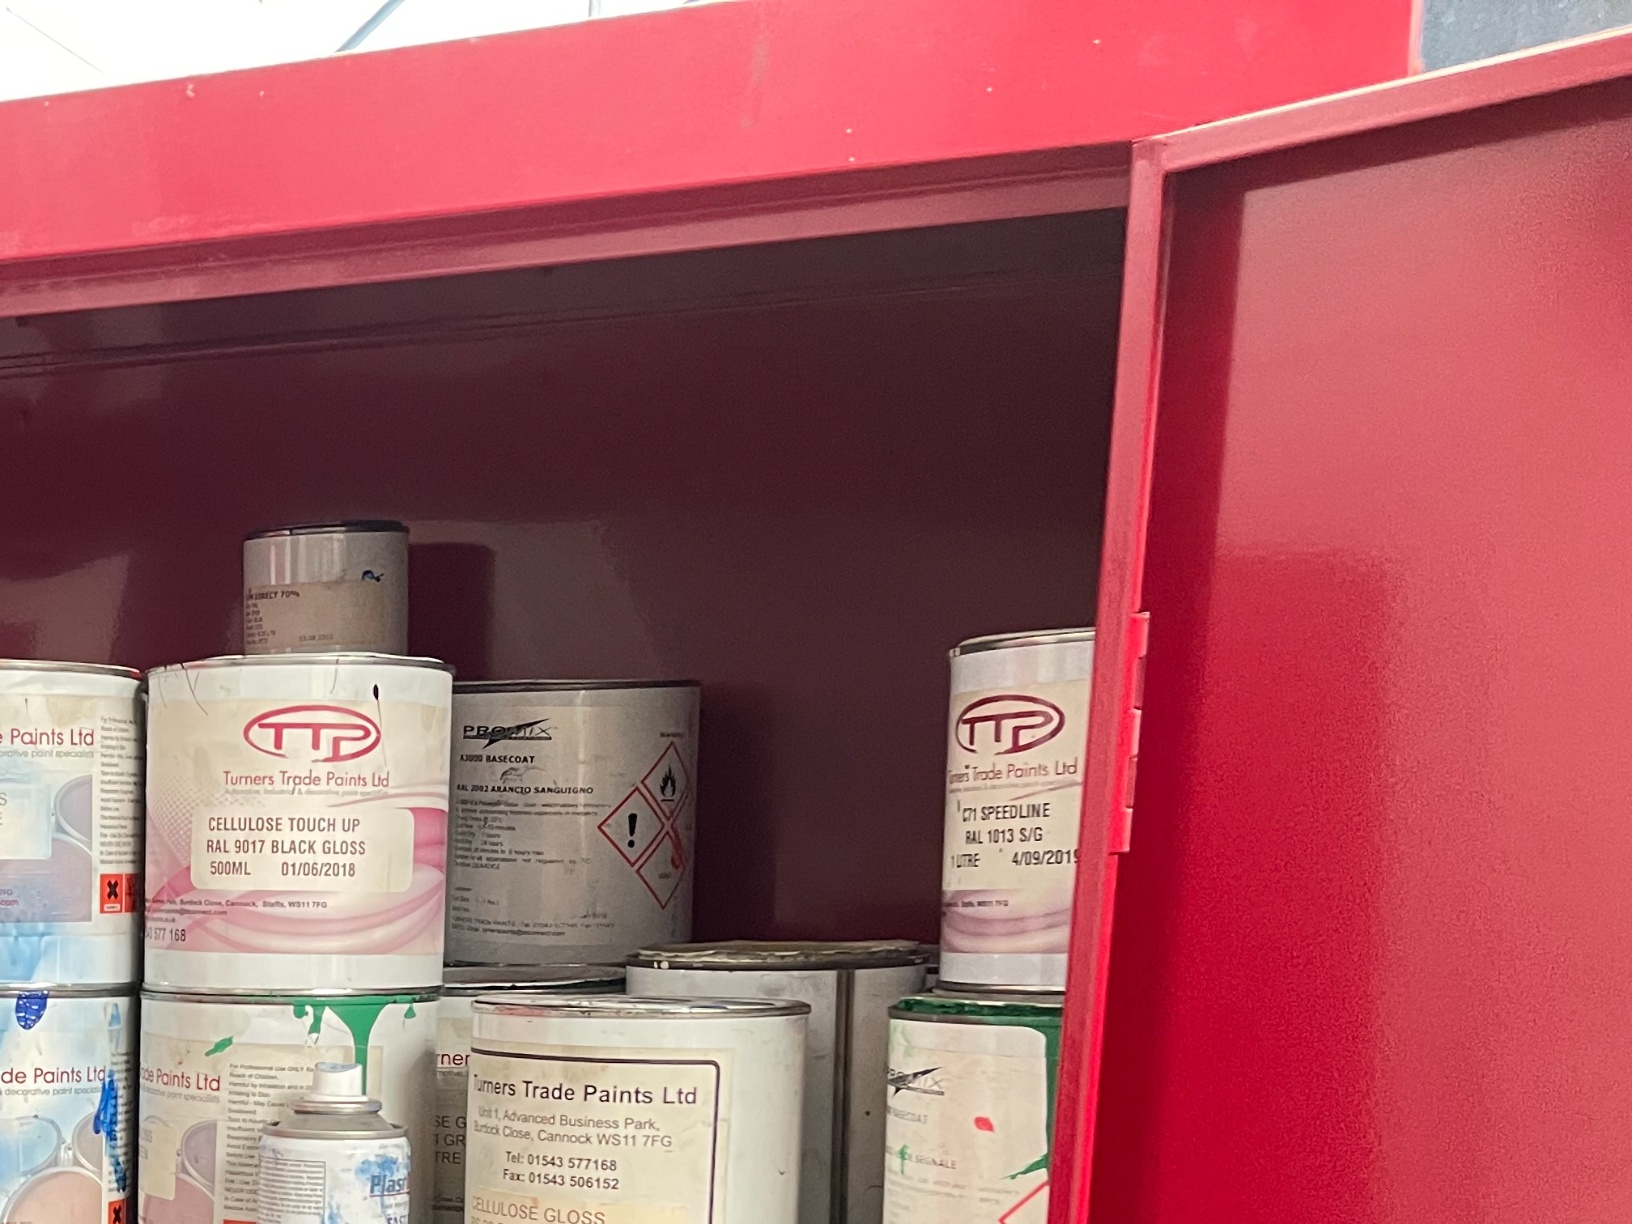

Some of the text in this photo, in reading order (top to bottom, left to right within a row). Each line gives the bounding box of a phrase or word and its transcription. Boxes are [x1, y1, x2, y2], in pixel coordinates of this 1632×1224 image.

[10, 728, 64, 746] Paints
[70, 729, 94, 746] Ltd
[31, 749, 53, 759] paint
[486, 755, 535, 764] BASECOAT
[972, 757, 1077, 781] Trade Paints Ltd
[224, 770, 389, 787] Turners Trade Paints Ltd
[490, 786, 531, 794] ARANCIO
[963, 803, 1050, 822] C71 SPEEDLINE
[208, 817, 360, 832] CELLULOSE TOUCH UP
[966, 827, 1042, 844] RAL 1013 S/G
[207, 839, 366, 855] RAL 9017 BLACK GLOSS
[210, 861, 356, 877] 500ML 01/06/2018
[169, 928, 187, 942] 168
[33, 1067, 81, 1084] Paints
[86, 1066, 106, 1082] Ltd
[156, 1071, 220, 1092] Paints Ltd
[474, 1075, 697, 1105] Turners Trade Paints Ltd
[503, 1110, 660, 1131] Advanced Business Park,
[502, 1125, 672, 1148] Close, Cannock WS11 7FG
[506, 1151, 617, 1171] Tel: 01543 577168
[503, 1169, 619, 1190] Fax: 01543 506152
[473, 1196, 539, 1220] CELLULOSE
